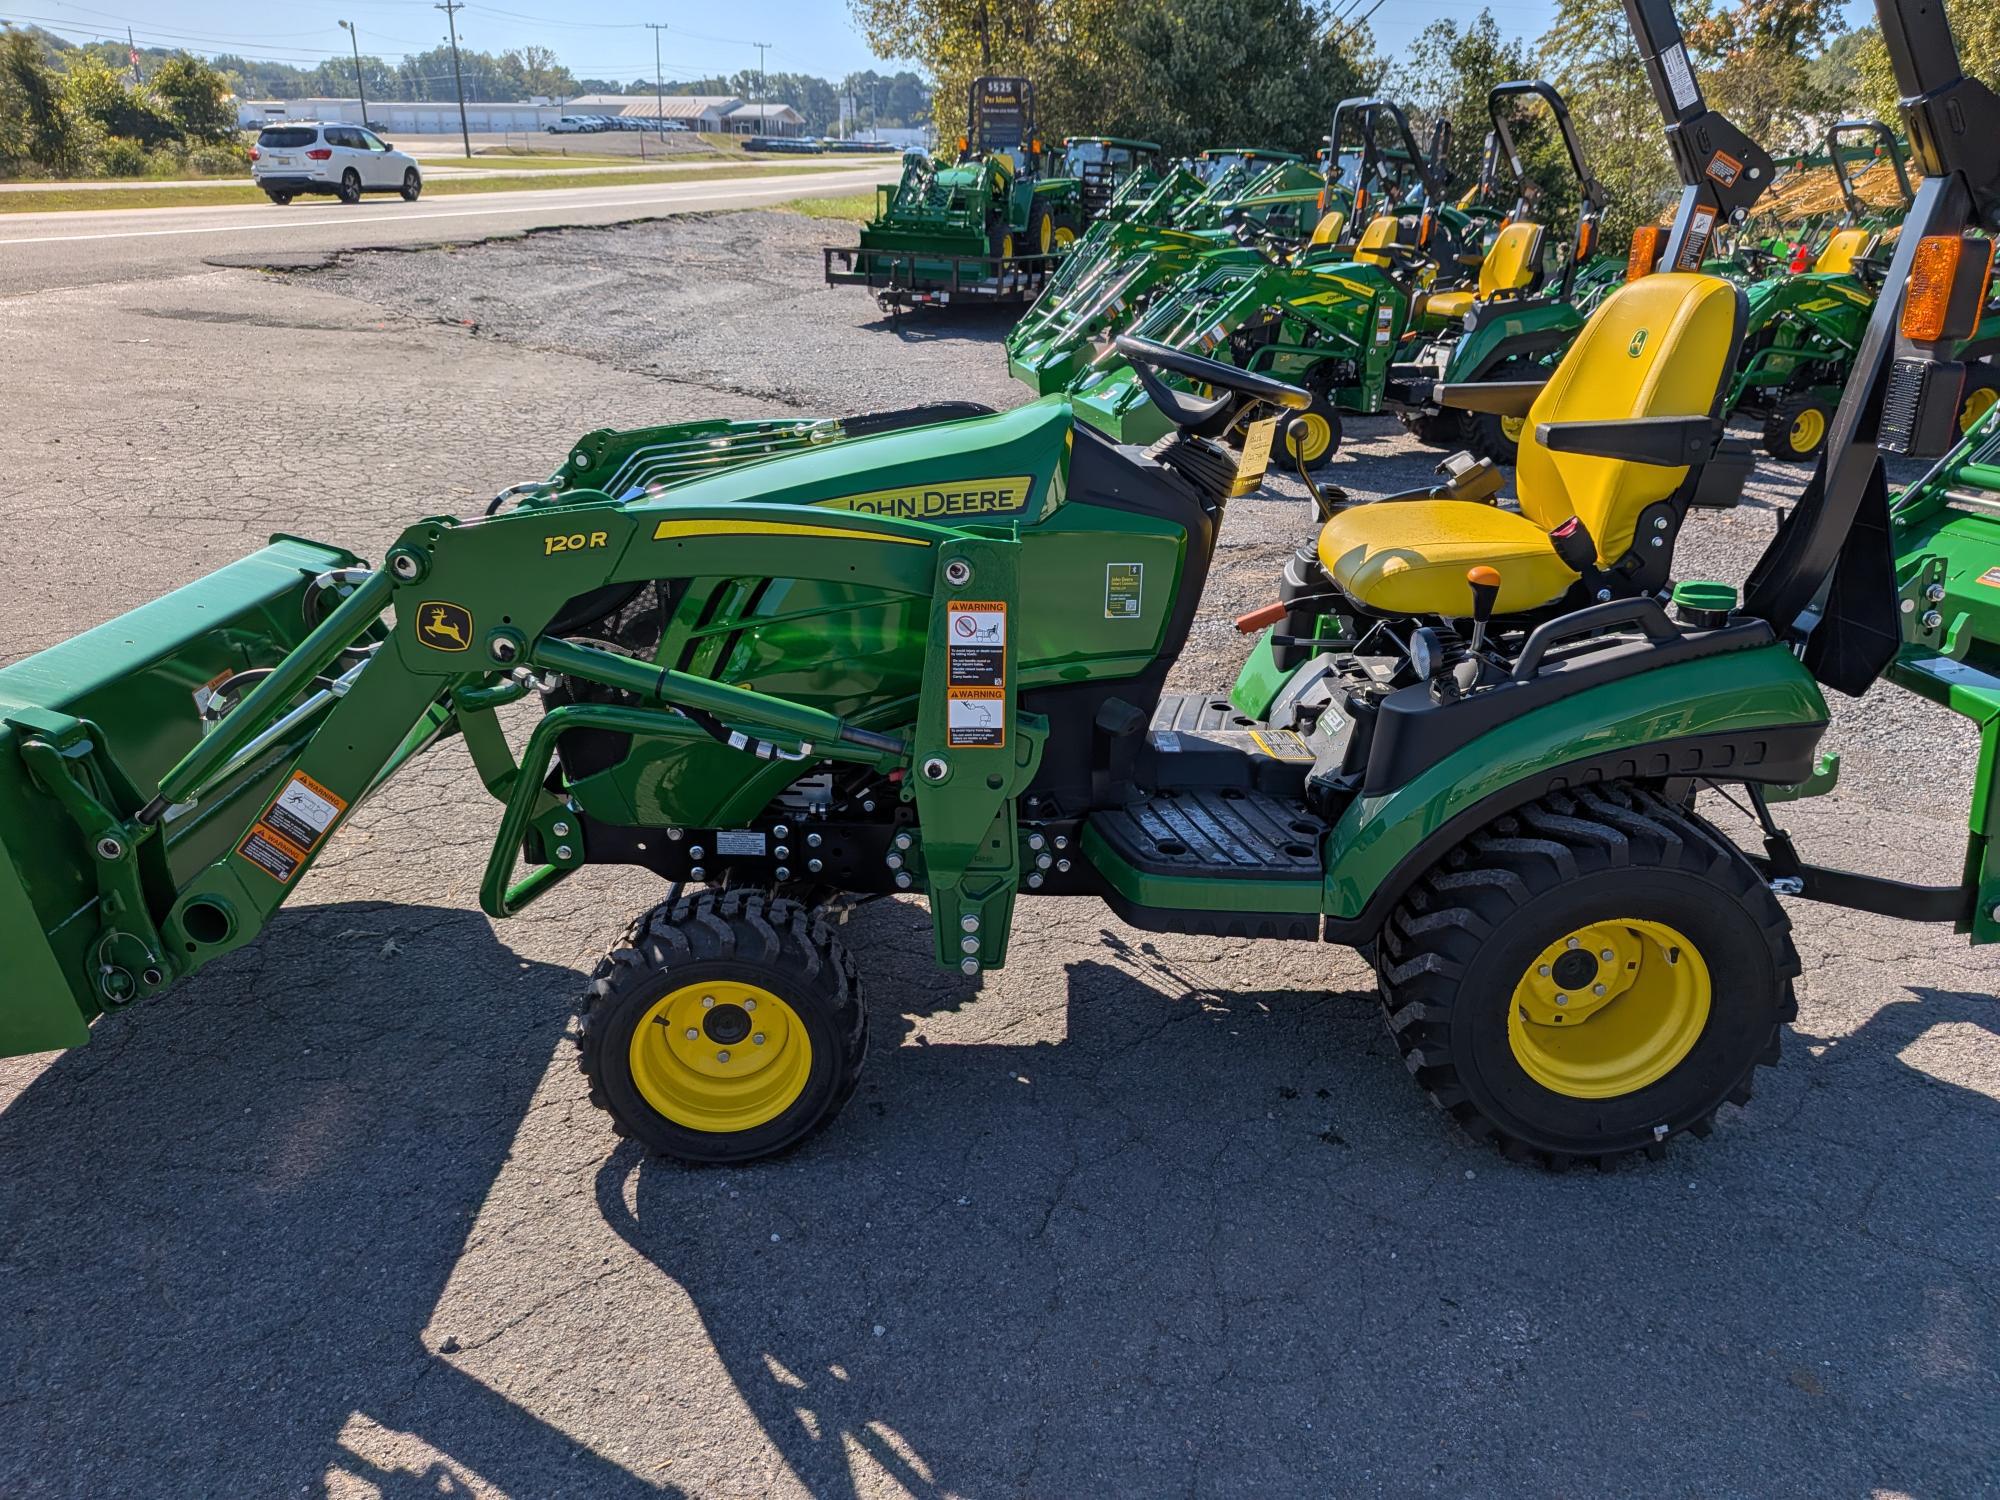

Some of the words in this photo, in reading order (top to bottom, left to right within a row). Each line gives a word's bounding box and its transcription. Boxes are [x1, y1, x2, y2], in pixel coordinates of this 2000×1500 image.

[924, 490, 1014, 514] DEERE
[545, 534, 586, 555] 120
[589, 531, 608, 548] R
[959, 690, 1002, 698] WARNING
[307, 781, 340, 806] WARNING
[267, 835, 300, 858] WARNING
